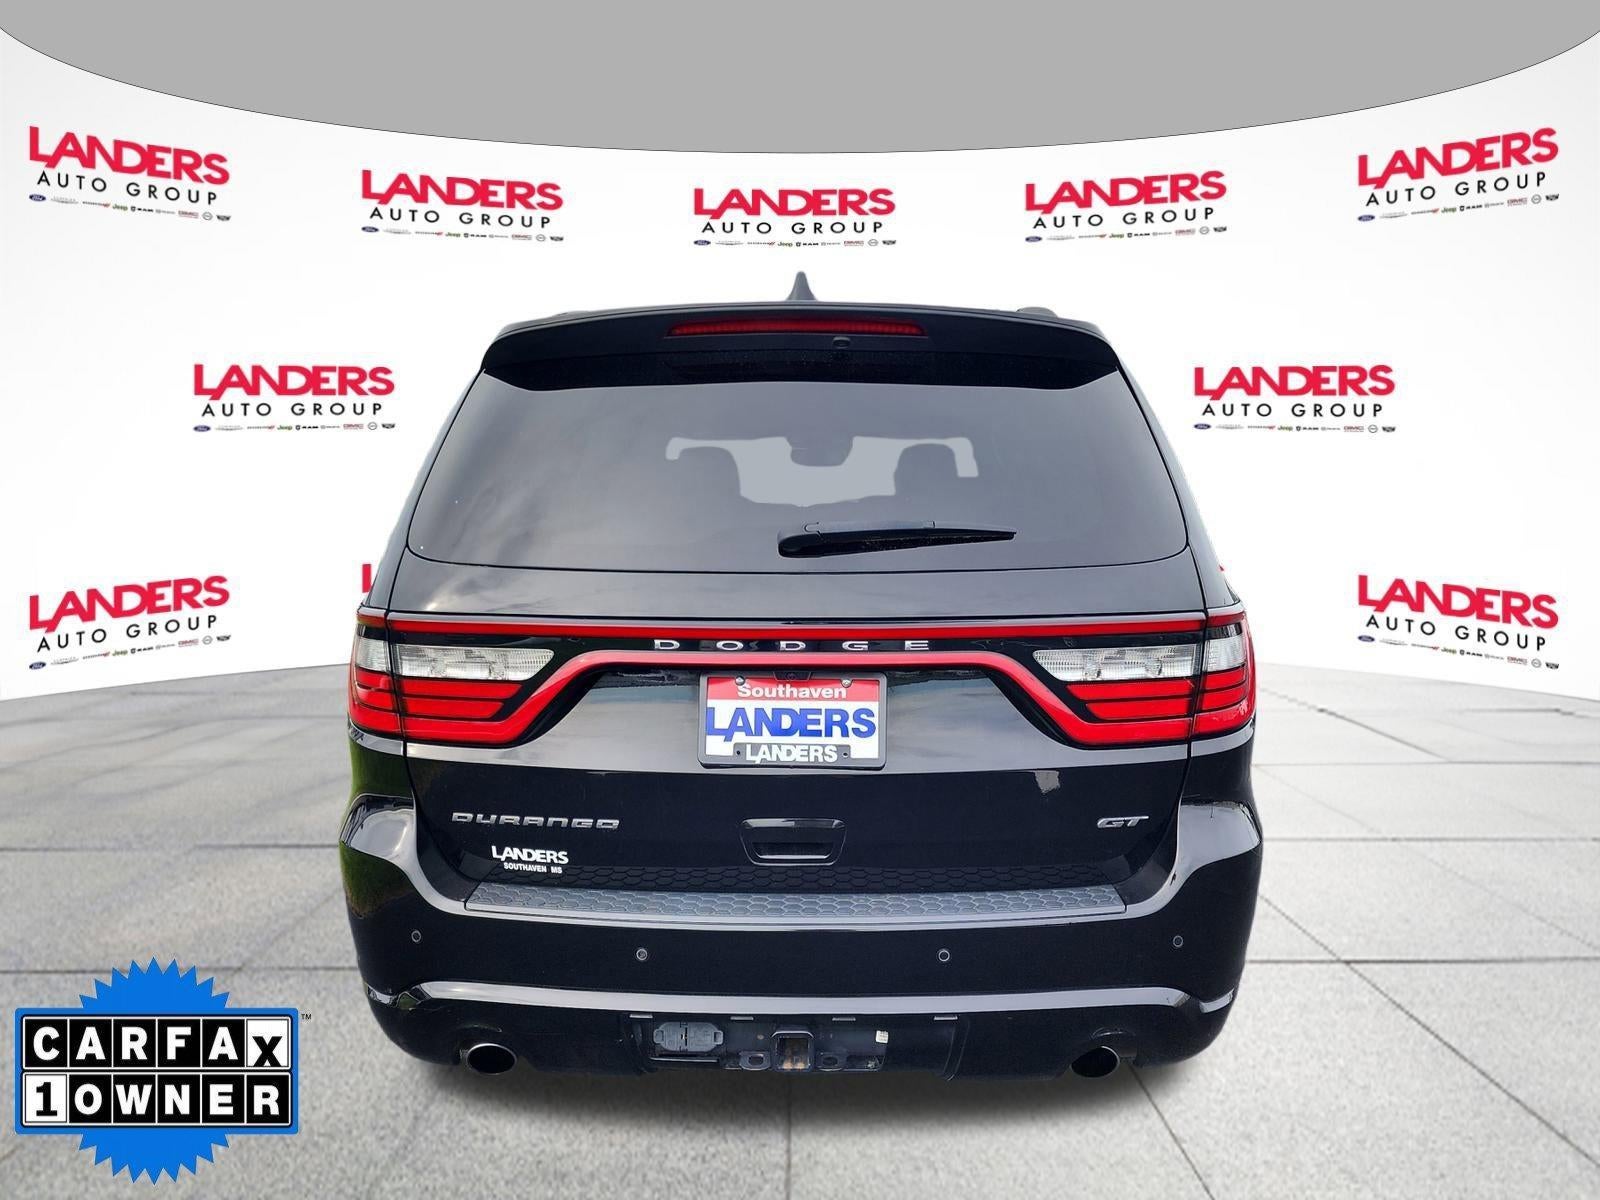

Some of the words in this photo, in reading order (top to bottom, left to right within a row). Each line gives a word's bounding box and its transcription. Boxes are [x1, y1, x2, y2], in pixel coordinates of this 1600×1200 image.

[30, 127, 229, 184] LANDERS
[1358, 128, 1558, 189] LANDERS
[37, 171, 106, 192] AUTO
[127, 183, 216, 204] GROUP
[362, 170, 563, 210] LANDERS
[694, 188, 895, 219] LANDERS
[1026, 171, 1226, 214] LANDERS
[1366, 186, 1435, 206] AUTO
[1455, 172, 1545, 195] GROUP
[370, 207, 439, 222] AUTO
[459, 213, 549, 228] GROUP
[702, 222, 771, 233] AUTO
[792, 222, 882, 234] GROUP
[1034, 215, 1103, 228] AUTO
[1123, 208, 1213, 224] GROUP
[194, 364, 394, 400] LANDERS
[1194, 365, 1395, 400] LANDERS
[202, 403, 271, 416] AUTO
[291, 403, 381, 415] GROUP
[1203, 404, 1271, 416] AUTO
[1292, 404, 1382, 417] GROUP
[30, 576, 229, 632] LANDERS
[1358, 576, 1558, 628] LANDERS
[38, 629, 106, 652] AUTO
[127, 615, 216, 638] GROUP
[654, 639, 930, 651] DODGE
[1367, 615, 1435, 635] AUTO
[1455, 626, 1545, 650] GROUP
[737, 684, 847, 699] Southaven
[706, 707, 876, 742] LANDERS
[746, 744, 837, 764] LANDERS
[451, 812, 620, 830] DURANGO
[1097, 815, 1150, 829] GT
[491, 845, 569, 865] LANDERS
[503, 862, 547, 873] SOUTHAVEN
[551, 866, 563, 874] MS
